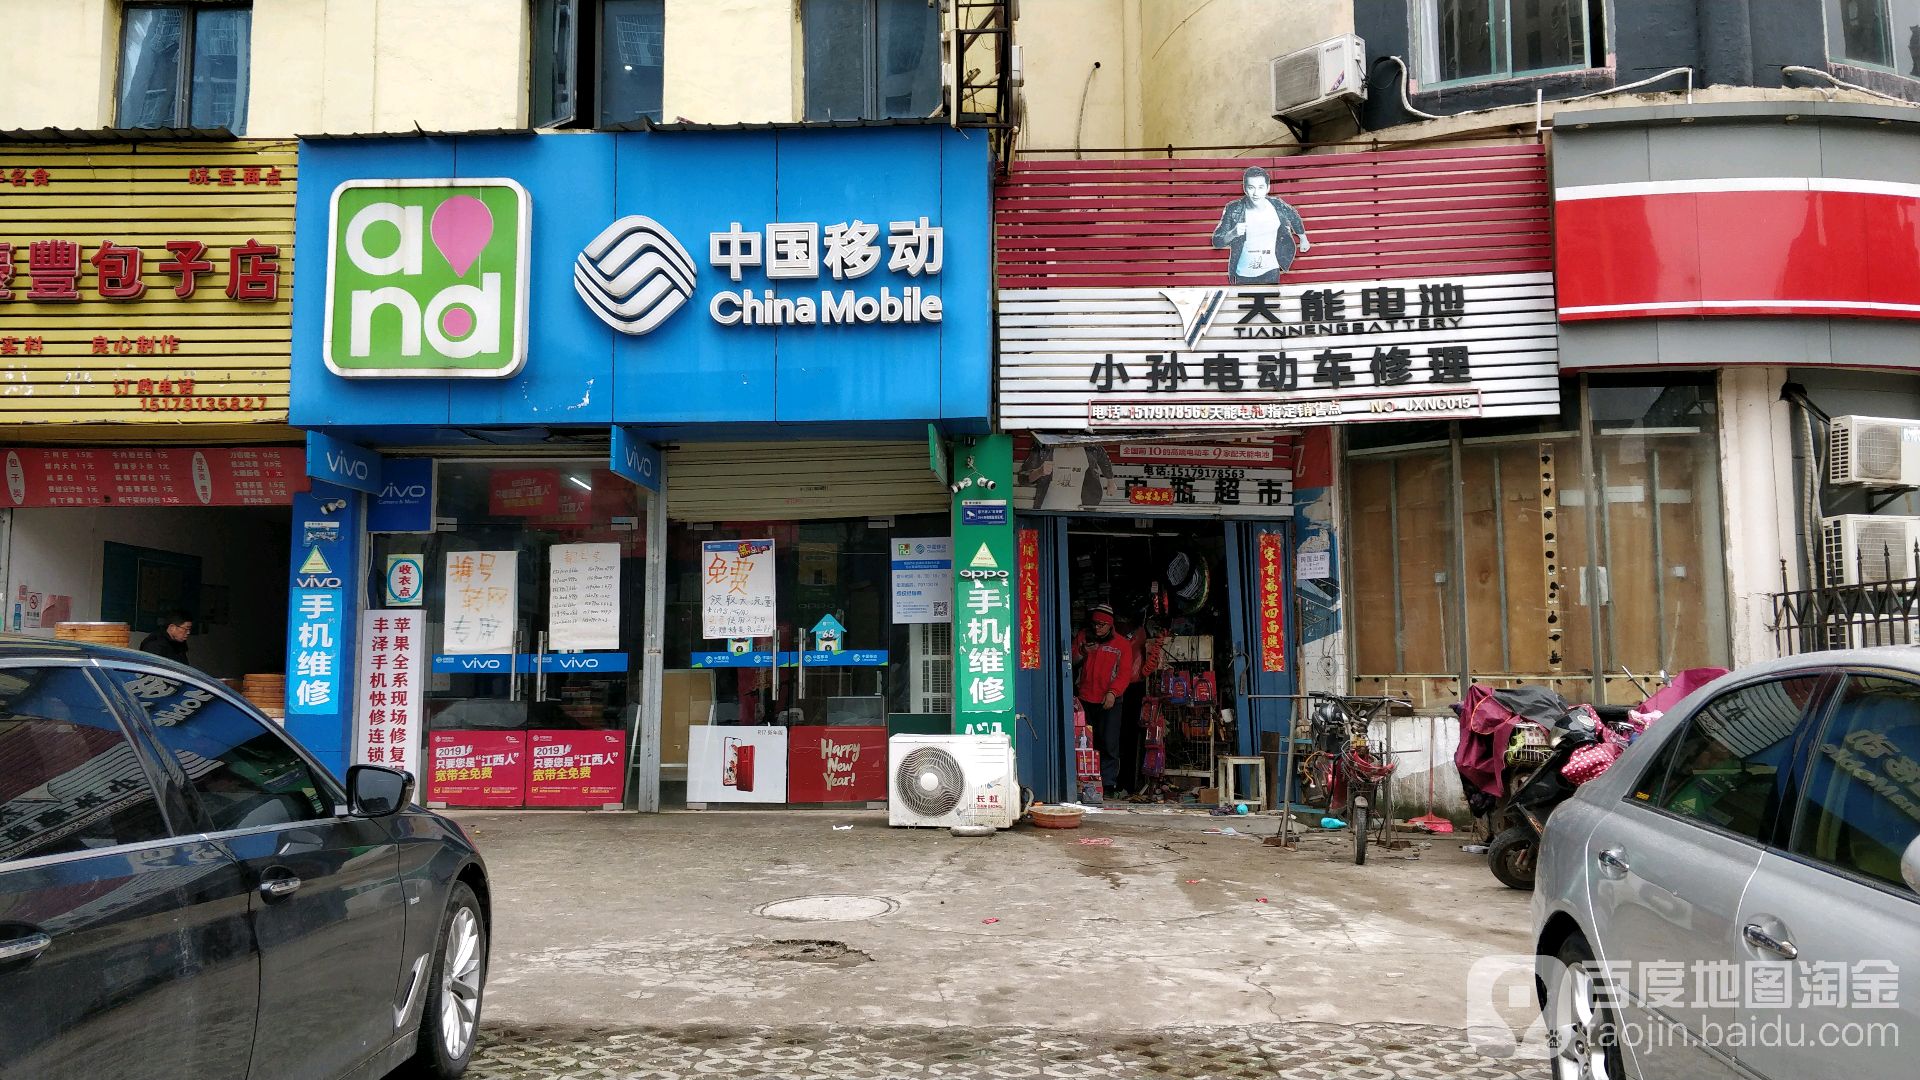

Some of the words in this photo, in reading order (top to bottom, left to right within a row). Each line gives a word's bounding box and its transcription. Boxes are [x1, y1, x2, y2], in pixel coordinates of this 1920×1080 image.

[0, 168, 50, 188] 名食
[710, 216, 943, 281] 中国移动
[710, 289, 815, 326] China
[821, 287, 943, 326] Mobile
[1237, 283, 1466, 326] 天能电池
[1233, 316, 1464, 339] TIANNENGBATTERY
[92, 334, 181, 354] 良心制作
[1090, 345, 1472, 395] 小孙电动车修理
[113, 378, 196, 396] 订购电话
[140, 396, 268, 412] 15179135827
[327, 450, 368, 481] vivo
[625, 445, 652, 477] vivo
[297, 574, 342, 588] vivo
[399, 564, 412, 597] 收衣点
[707, 552, 754, 595] 免费
[297, 594, 335, 706] 手机维修
[967, 588, 1006, 704] 手机维修
[462, 657, 501, 669] vivo
[560, 656, 599, 669] vivo
[367, 617, 389, 763] 丰泽手机快修连锁
[438, 747, 462, 756] 2019
[536, 746, 560, 756] 2019
[820, 738, 861, 761] Happy
[435, 766, 493, 782] 宽带全免费
[533, 766, 592, 782] 宽带全免费
[827, 757, 854, 775] New
[822, 772, 856, 791] Year!
[976, 794, 999, 803] 长虹
